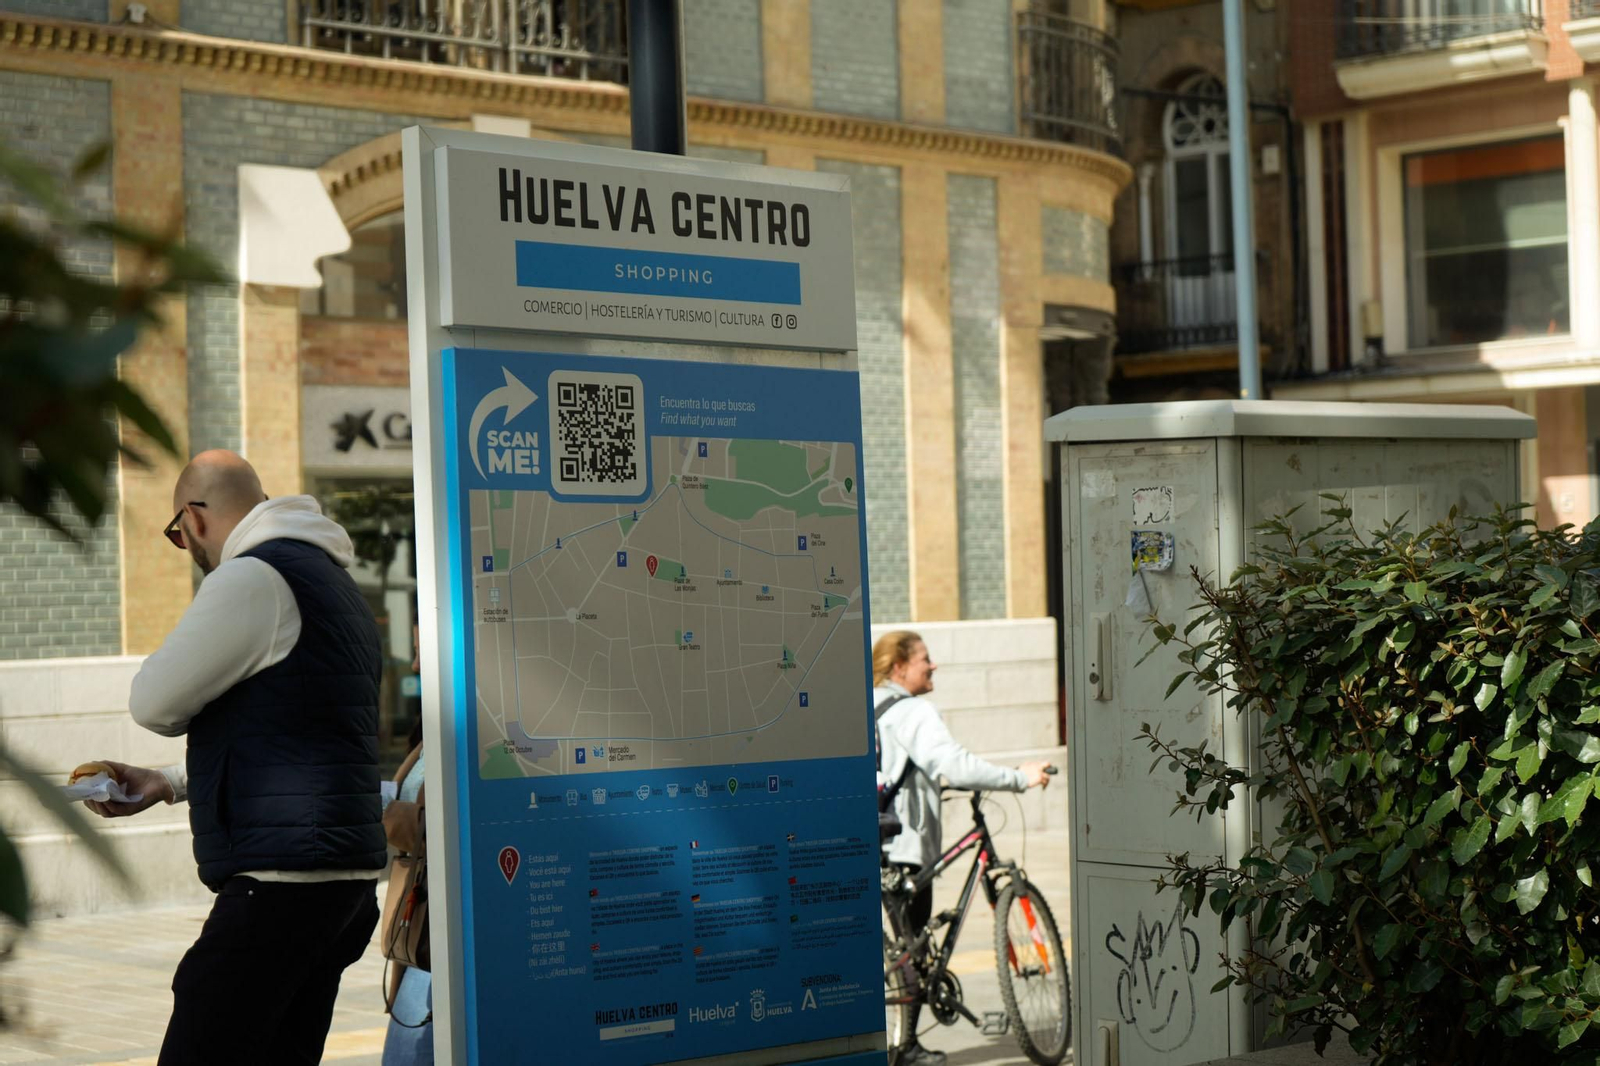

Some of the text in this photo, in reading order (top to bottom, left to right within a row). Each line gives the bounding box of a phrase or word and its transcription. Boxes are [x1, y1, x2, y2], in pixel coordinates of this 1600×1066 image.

[498, 167, 810, 247] HUELVA CENTRO
[614, 263, 714, 285] SHOPPING
[523, 299, 582, 315] COMERCIO
[591, 303, 655, 319] HOSTELERÍA
[656, 308, 664, 321] Y
[665, 308, 713, 324] TURISMO
[719, 312, 765, 327] CULTURA
[660, 395, 756, 413] Encuentra lo que buscas
[660, 412, 737, 430] Find what you want
[486, 430, 539, 448] SCAN
[487, 448, 541, 475] ME!
[608, 746, 629, 754] Mercado
[608, 753, 636, 762] del Carmen
[529, 880, 541, 889] You
[552, 879, 566, 887] here
[530, 893, 537, 902] Tu
[545, 892, 553, 901] ici
[530, 904, 563, 915] Du bist hier
[530, 919, 540, 928] Ets
[531, 931, 552, 941] Hemen
[818, 986, 831, 994] Junta
[595, 1002, 678, 1025] HUELVA CENTRO
[688, 1003, 736, 1023] Huelva
[766, 1005, 793, 1017] HUELVA
[624, 1026, 651, 1034] SHOPPING
